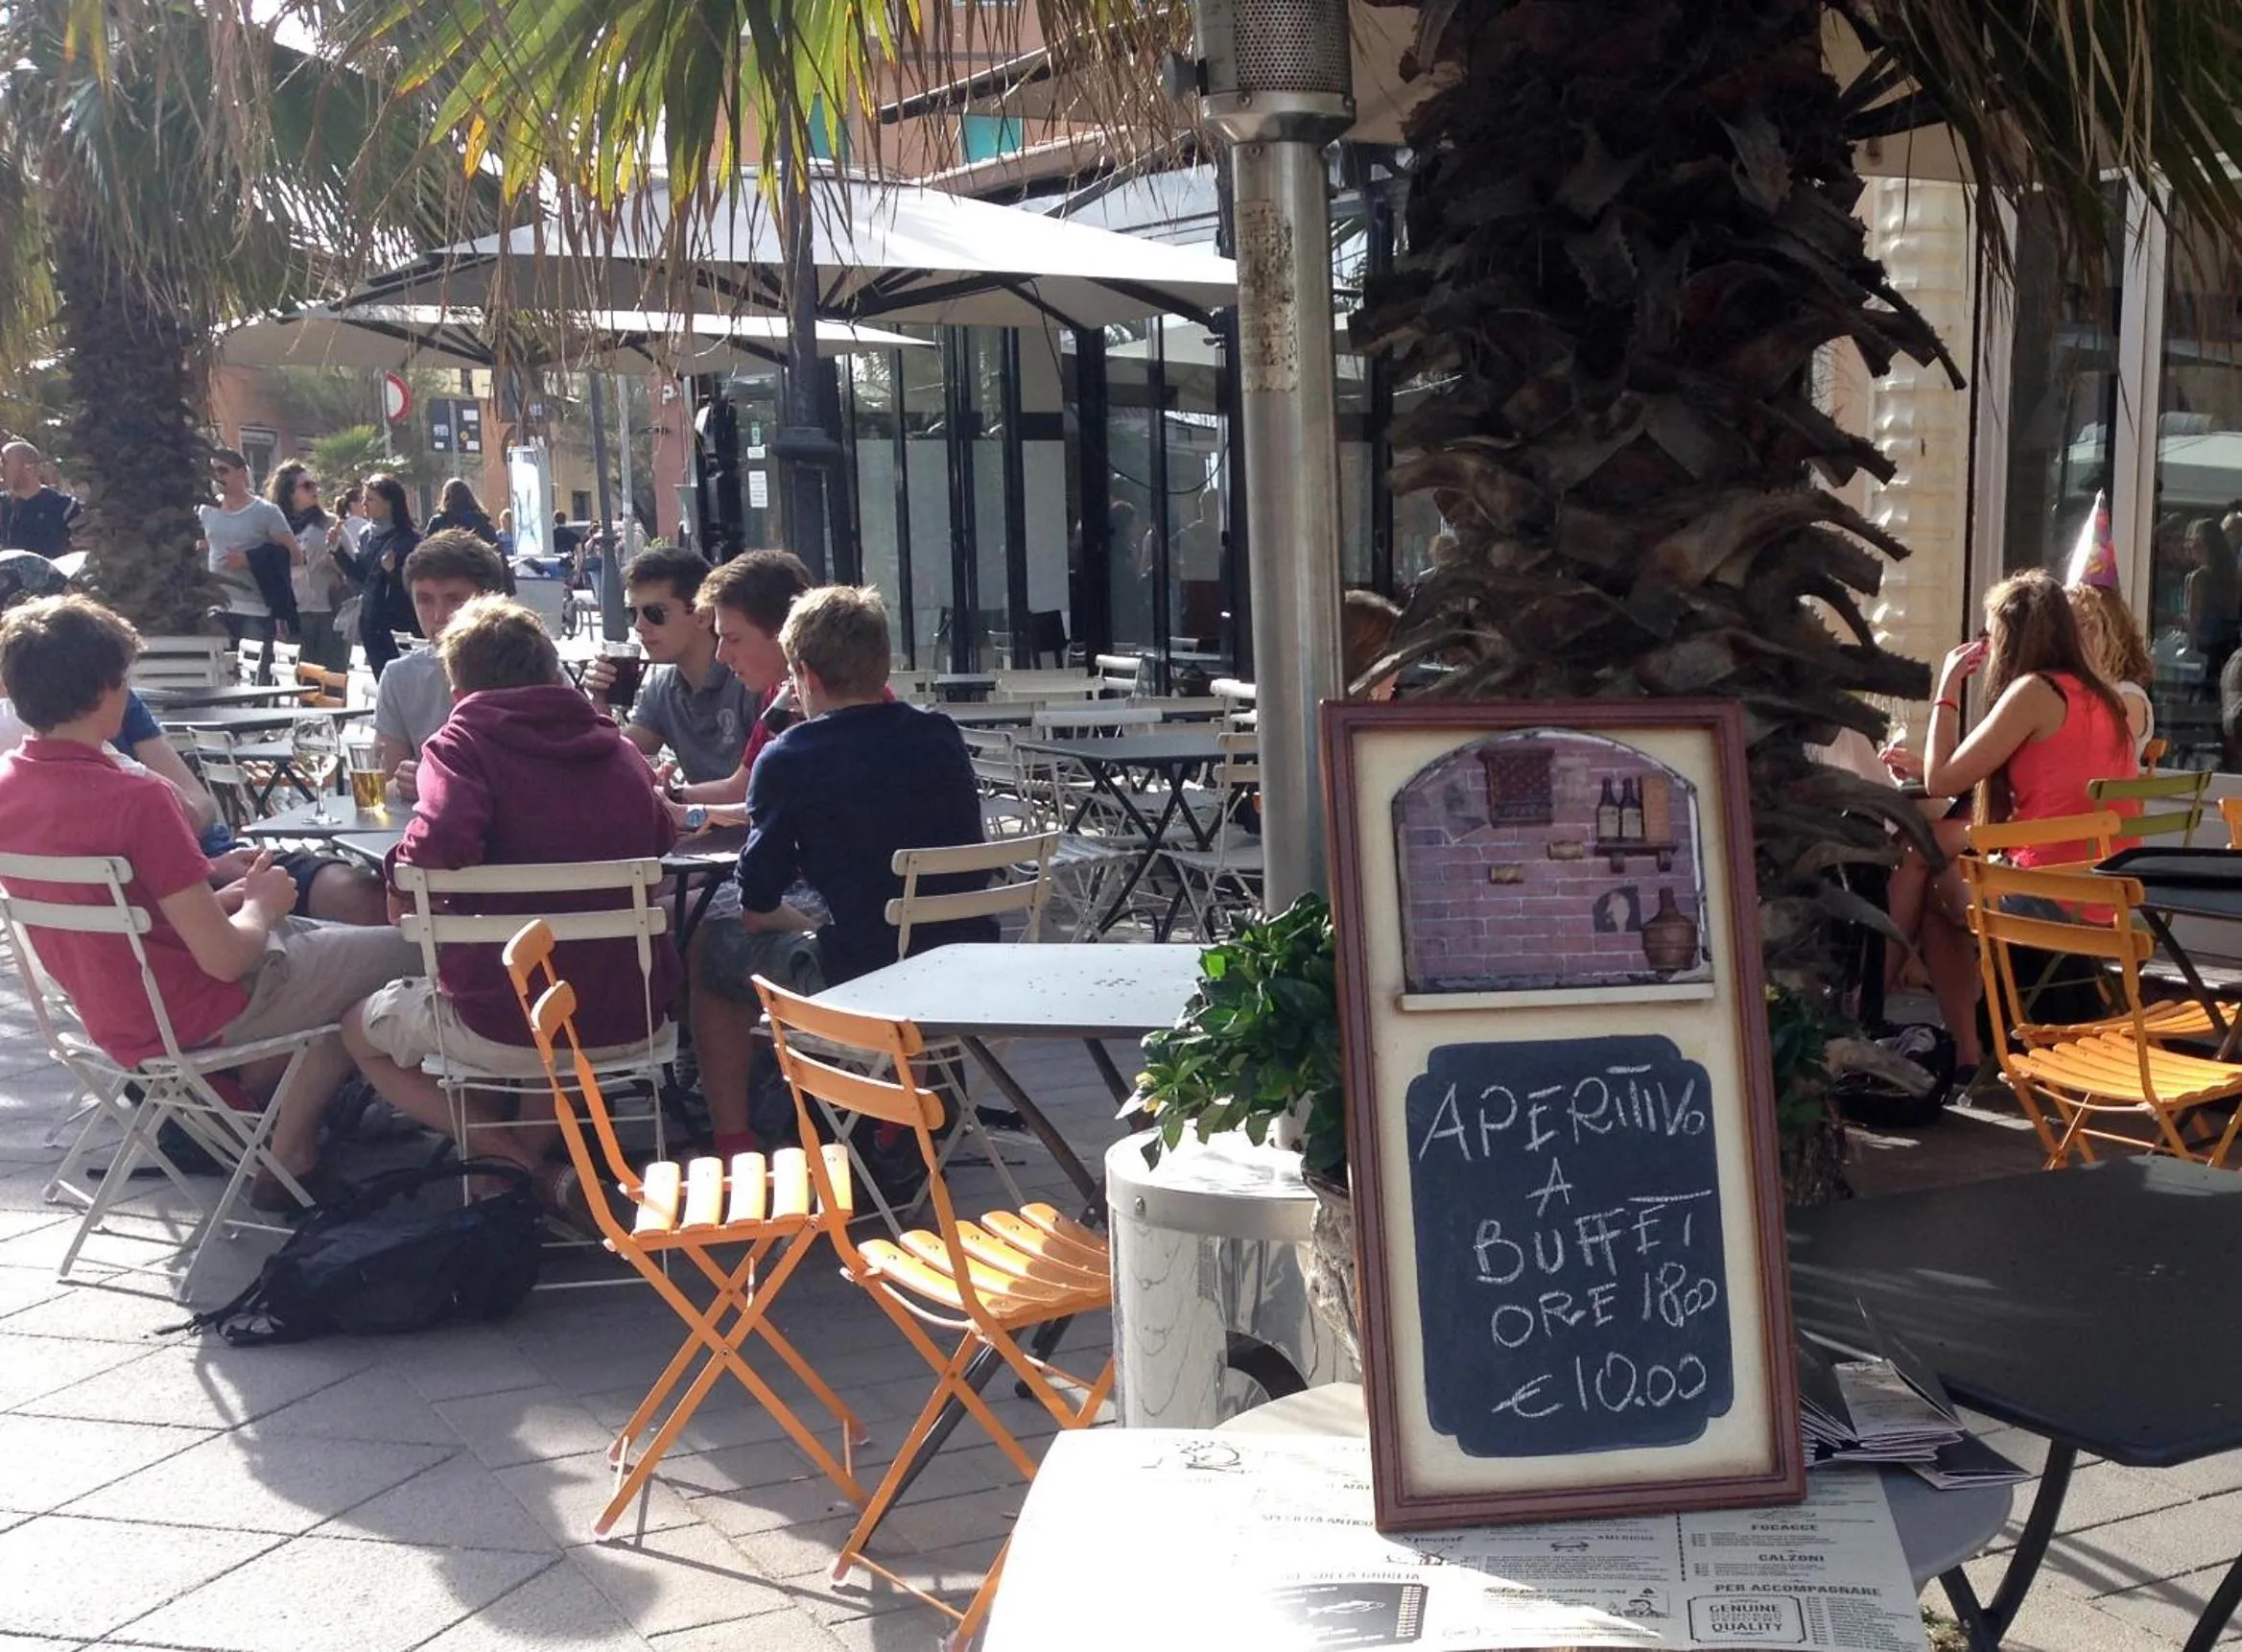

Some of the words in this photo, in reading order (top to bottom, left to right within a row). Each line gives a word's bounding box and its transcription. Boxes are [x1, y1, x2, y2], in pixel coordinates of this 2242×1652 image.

[1419, 1065, 1705, 1162] APERITIVO
[1525, 1157, 1573, 1217] A
[1474, 1190, 1712, 1285] BUFFET
[1491, 1282, 1617, 1347] ORE
[1758, 1553, 1826, 1563] CALZONI
[1710, 1603, 1780, 1614] GENUINE
[1714, 1584, 1746, 1593] PER
[1751, 1584, 1883, 1597] ACCOMPAGNARE
[1711, 1620, 1783, 1633] QUALITY
